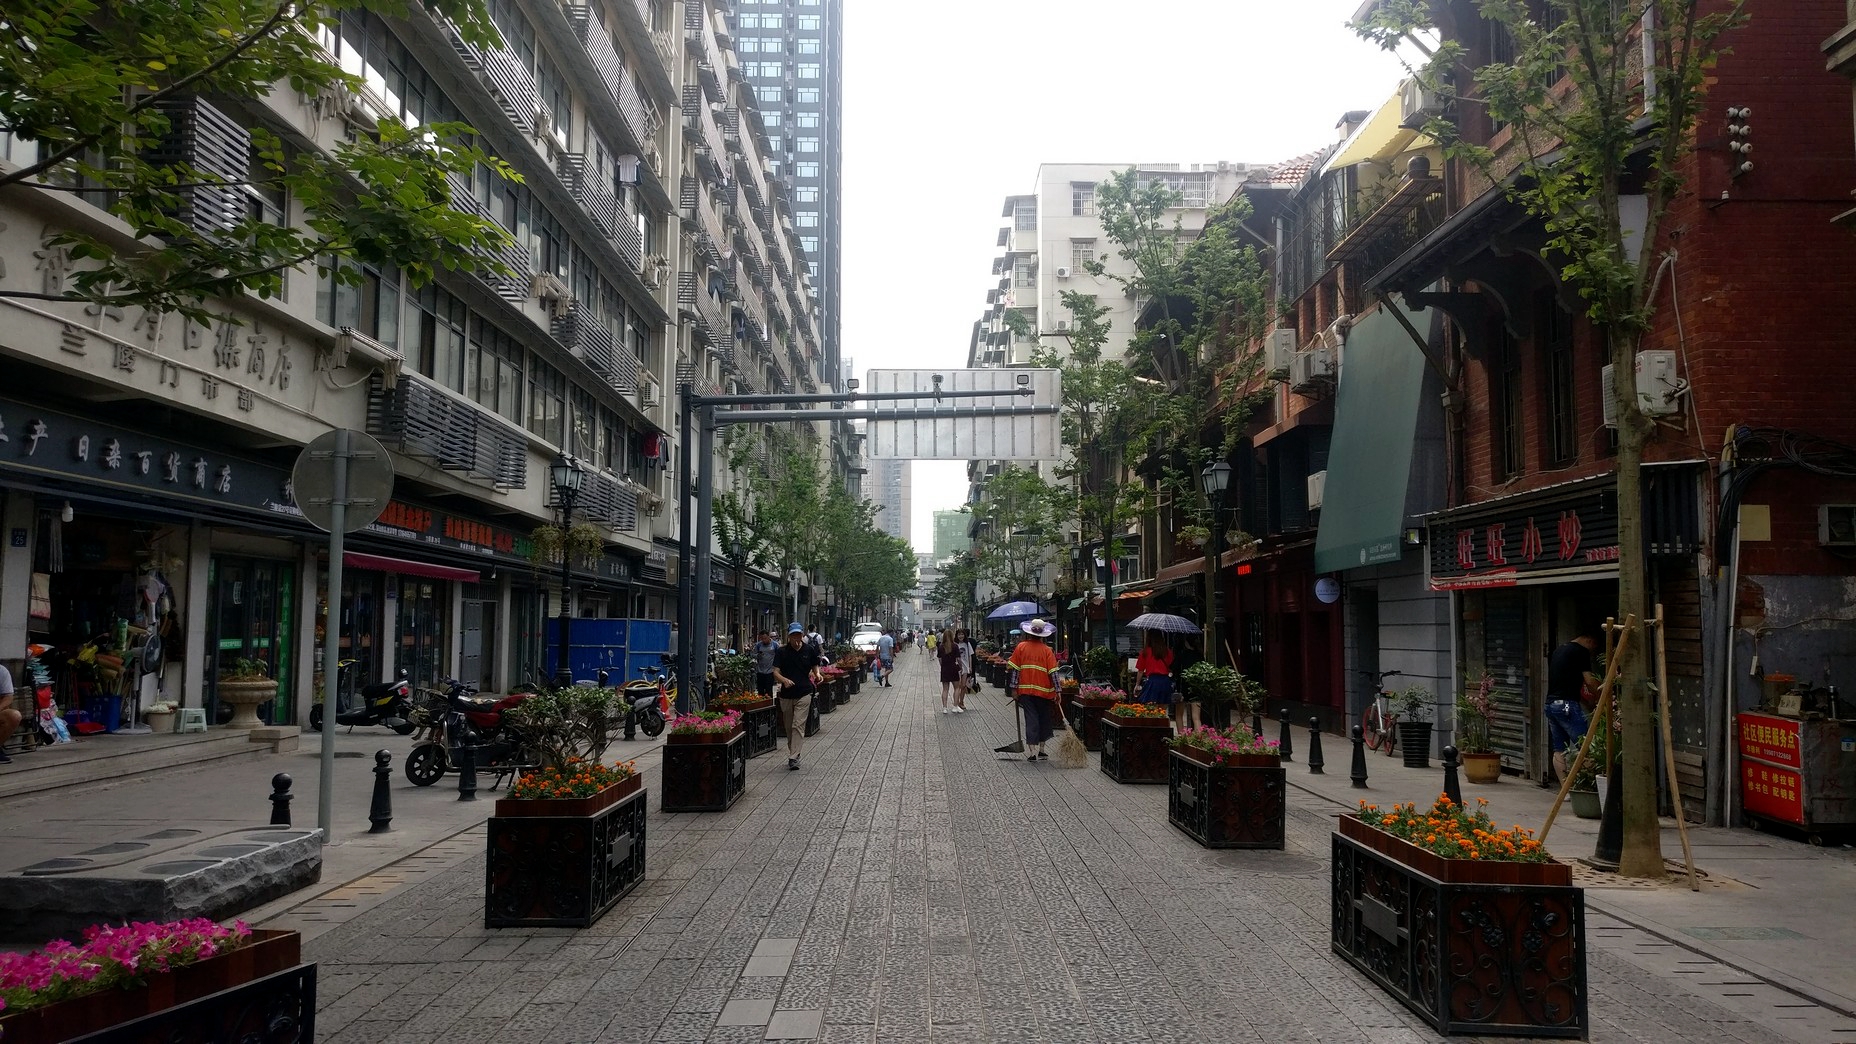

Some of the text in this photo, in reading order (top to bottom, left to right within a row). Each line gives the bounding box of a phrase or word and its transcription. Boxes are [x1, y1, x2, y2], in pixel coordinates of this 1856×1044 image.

[60, 323, 256, 413] 兰陵门市部
[1455, 510, 1582, 570] 旺旺小炒
[1743, 723, 1796, 749] 社区便民服务点
[1772, 786, 1796, 801] 配钥匙
